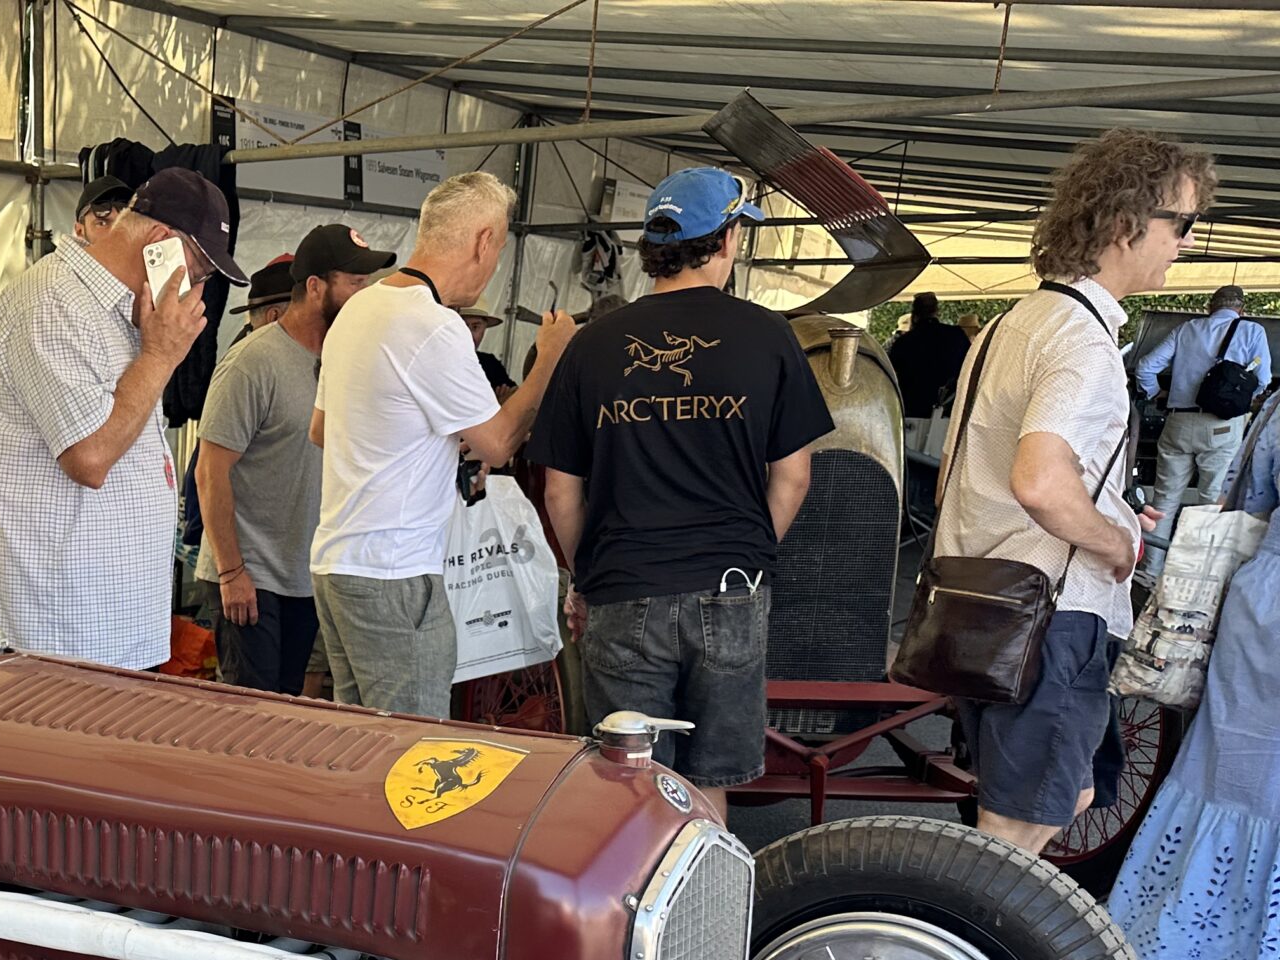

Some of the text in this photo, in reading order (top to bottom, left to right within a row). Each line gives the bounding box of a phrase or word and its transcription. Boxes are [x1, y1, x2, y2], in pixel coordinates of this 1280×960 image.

[596, 395, 747, 429] ARC'TERYX
[470, 542, 519, 564] RIVALS
[470, 561, 492, 576] EPIC
[448, 576, 483, 591] RACING
[400, 795, 416, 808] S
